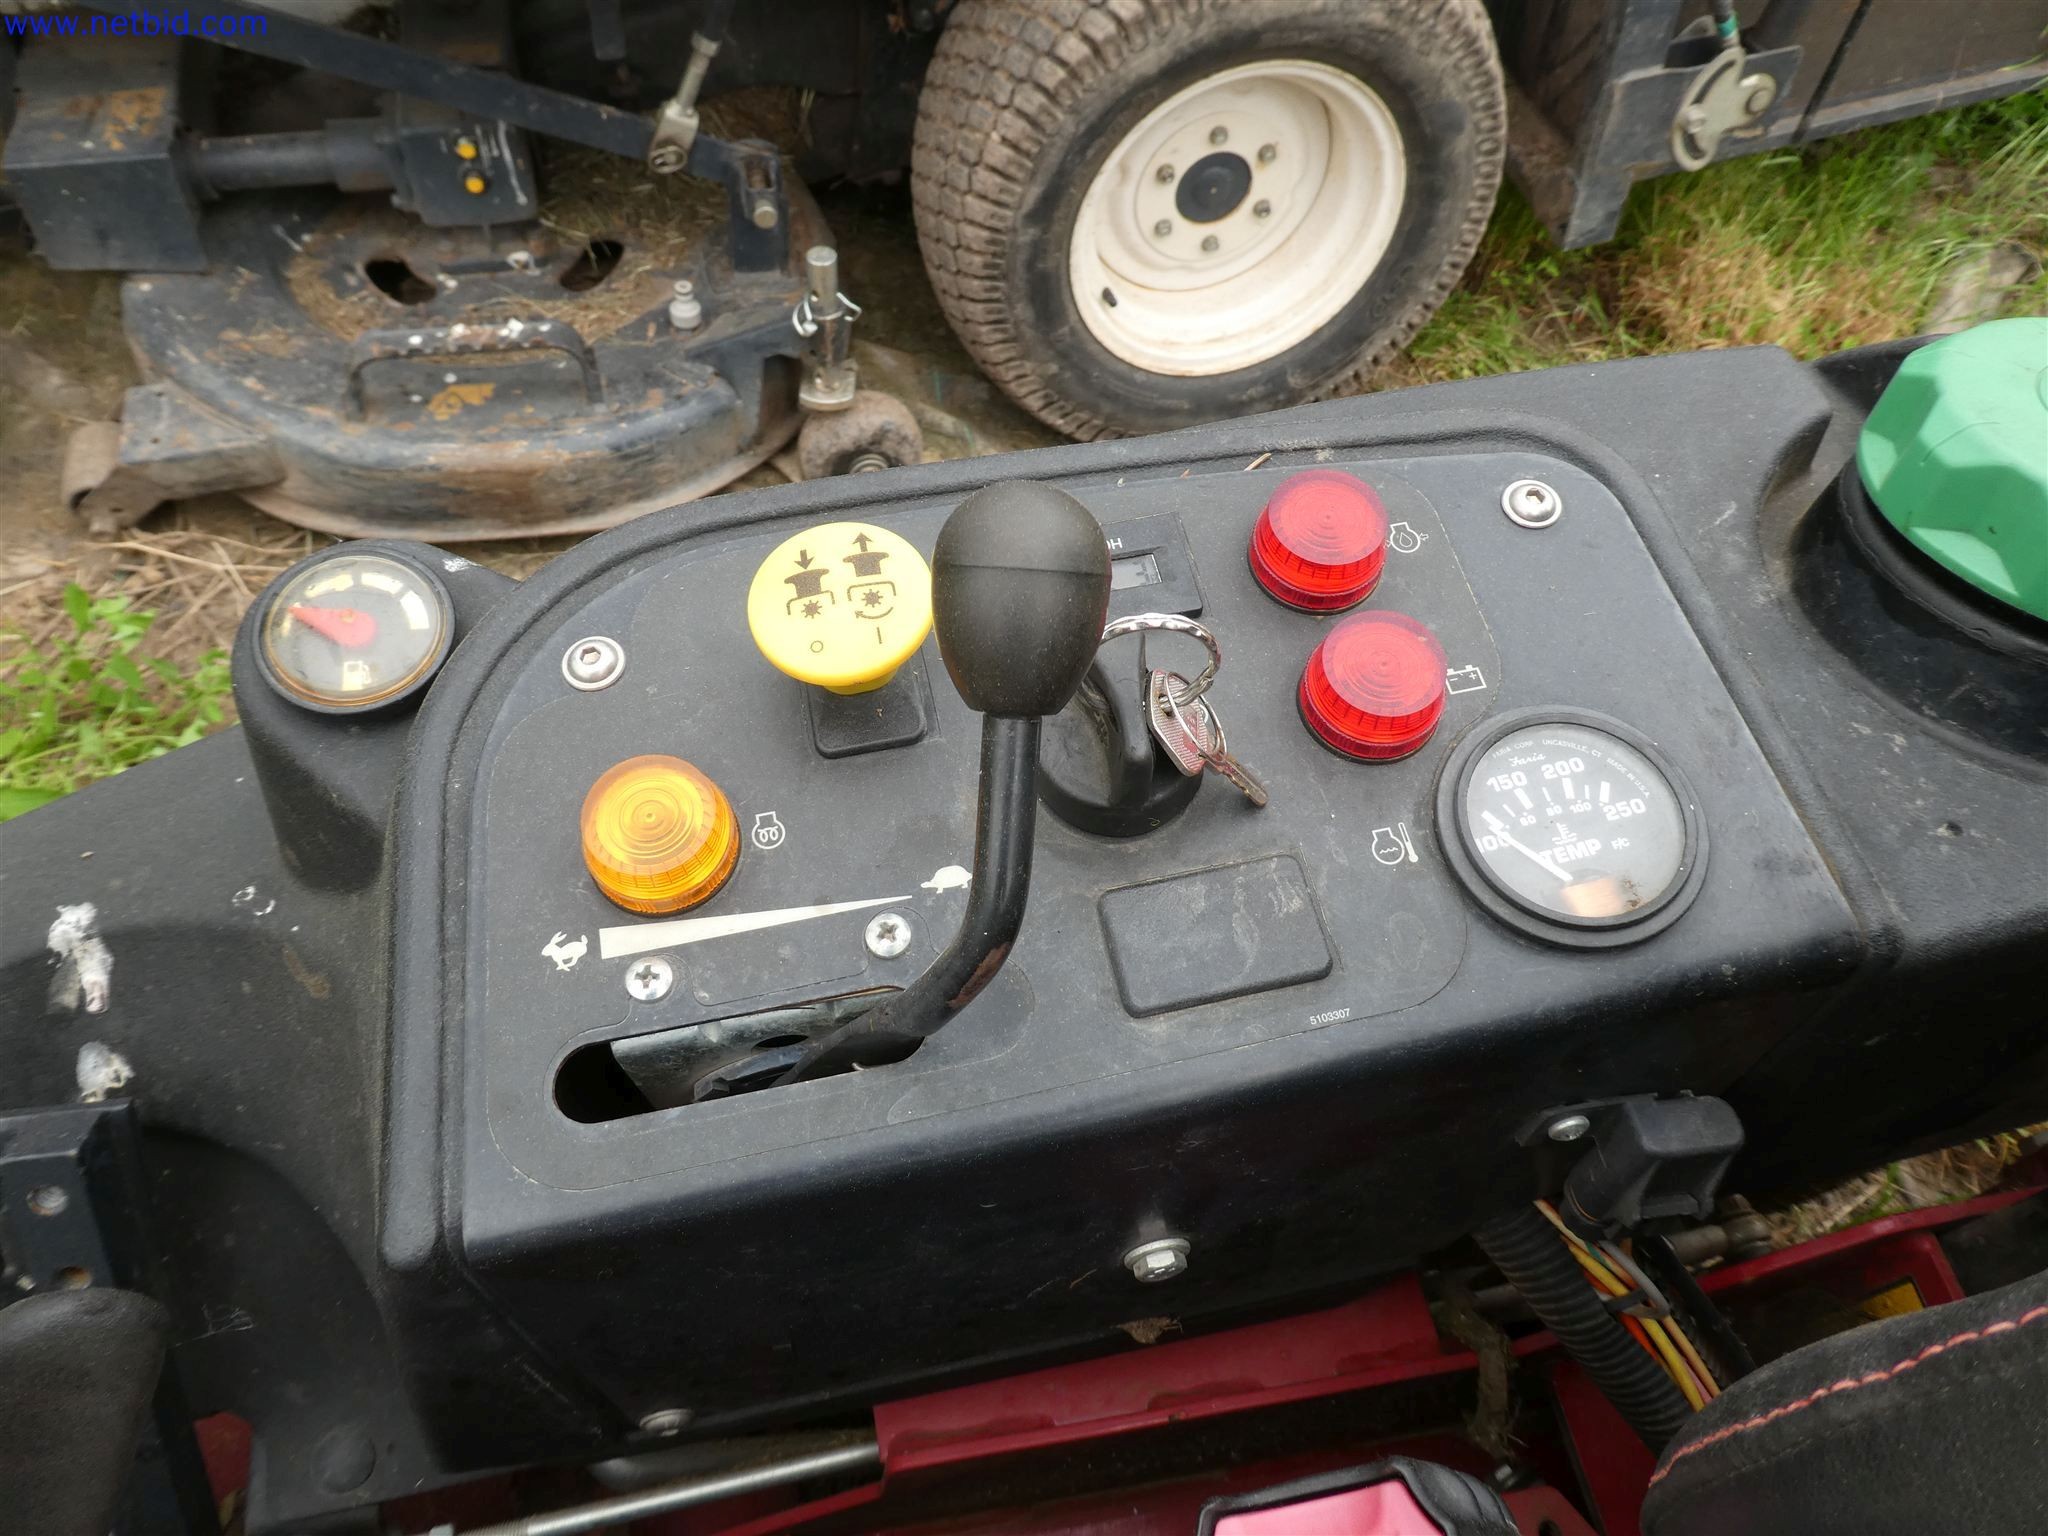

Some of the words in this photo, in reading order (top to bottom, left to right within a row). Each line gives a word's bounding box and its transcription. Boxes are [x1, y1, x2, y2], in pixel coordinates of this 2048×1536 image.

[1508, 752, 1547, 767] Faria
[1486, 770, 1528, 792] 150
[1541, 756, 1585, 780] 200
[1569, 801, 1592, 814] 100
[1602, 798, 1646, 821] 250
[1538, 838, 1602, 864] TEMP
[1310, 1008, 1350, 1025] 5103307
